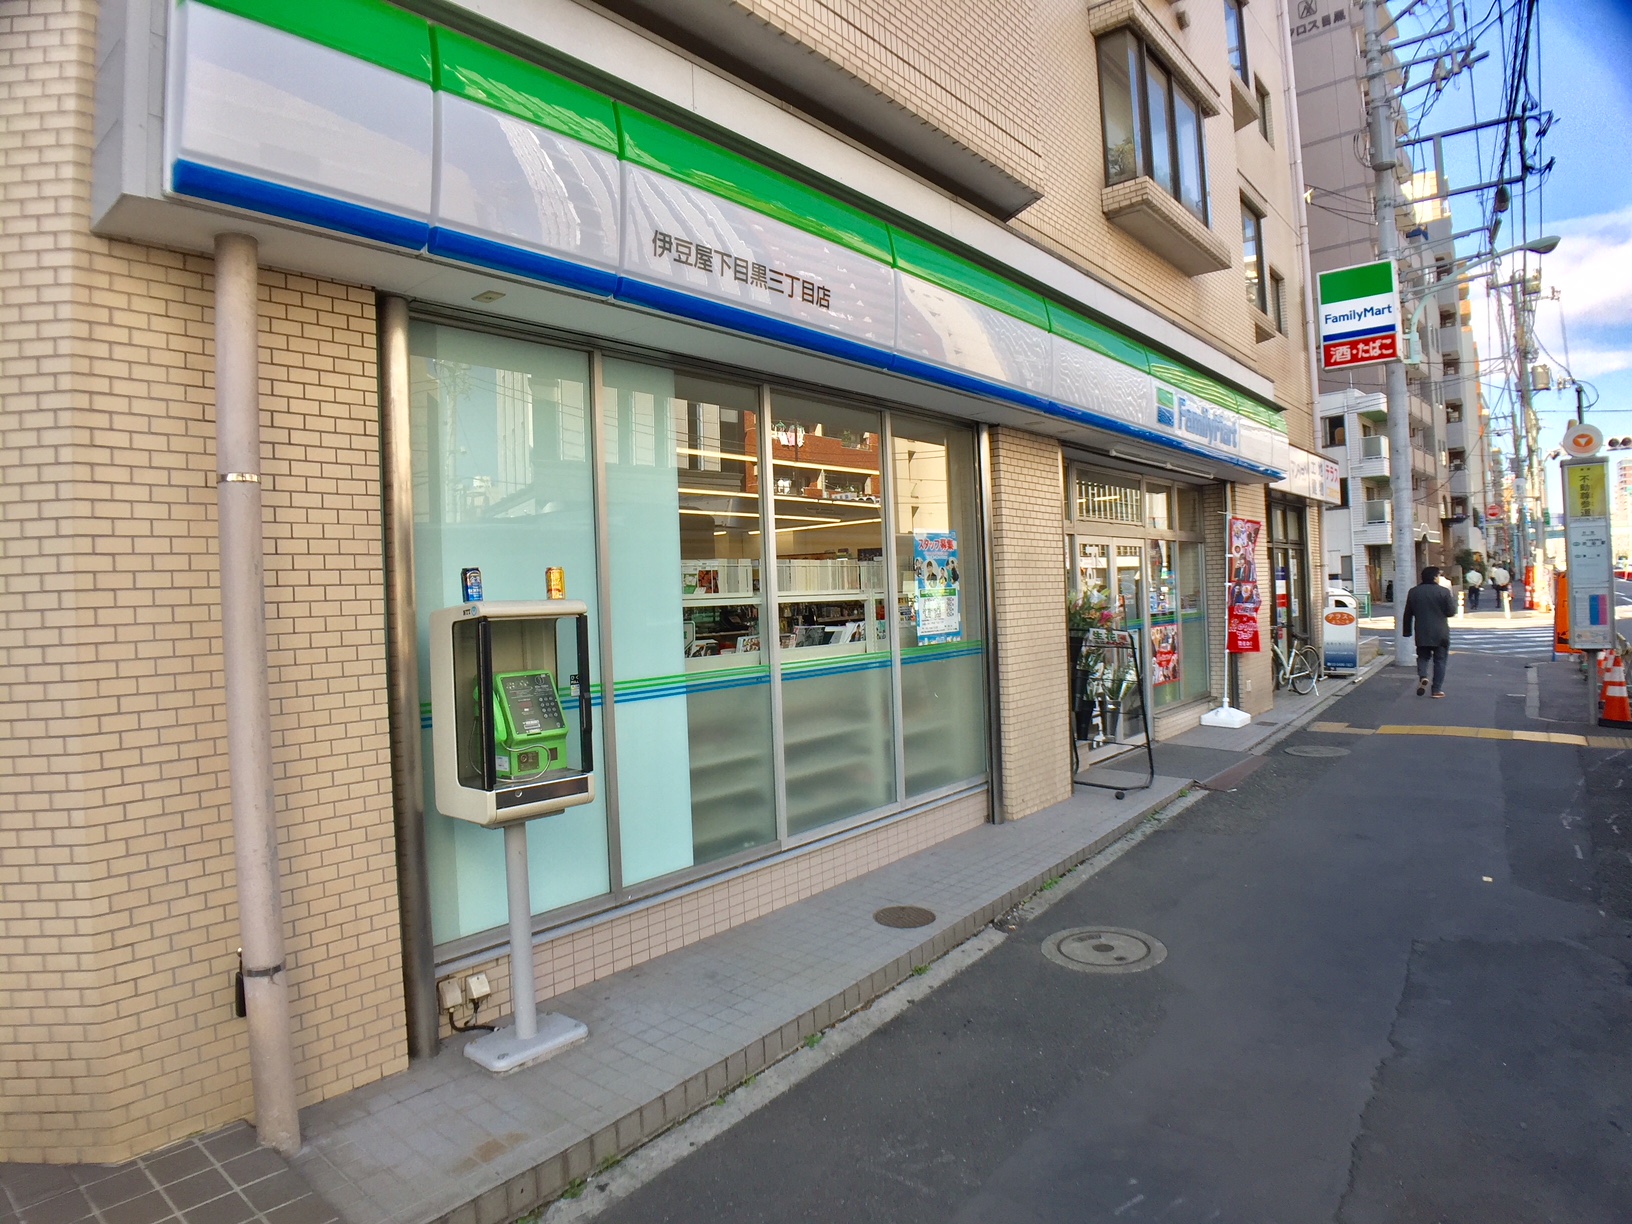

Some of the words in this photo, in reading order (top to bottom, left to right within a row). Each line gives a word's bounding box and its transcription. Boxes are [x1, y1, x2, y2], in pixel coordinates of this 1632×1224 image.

[651, 229, 832, 310] 伊豆屋下目黒三丁目店
[1324, 304, 1393, 325] FamilyMart
[1329, 338, 1394, 363] 酒・たばこ
[1178, 396, 1238, 448] FamilyMart
[1325, 464, 1339, 483] テラス
[1579, 475, 1592, 517] 不動尊参道
[918, 537, 955, 552] スタッフ募集
